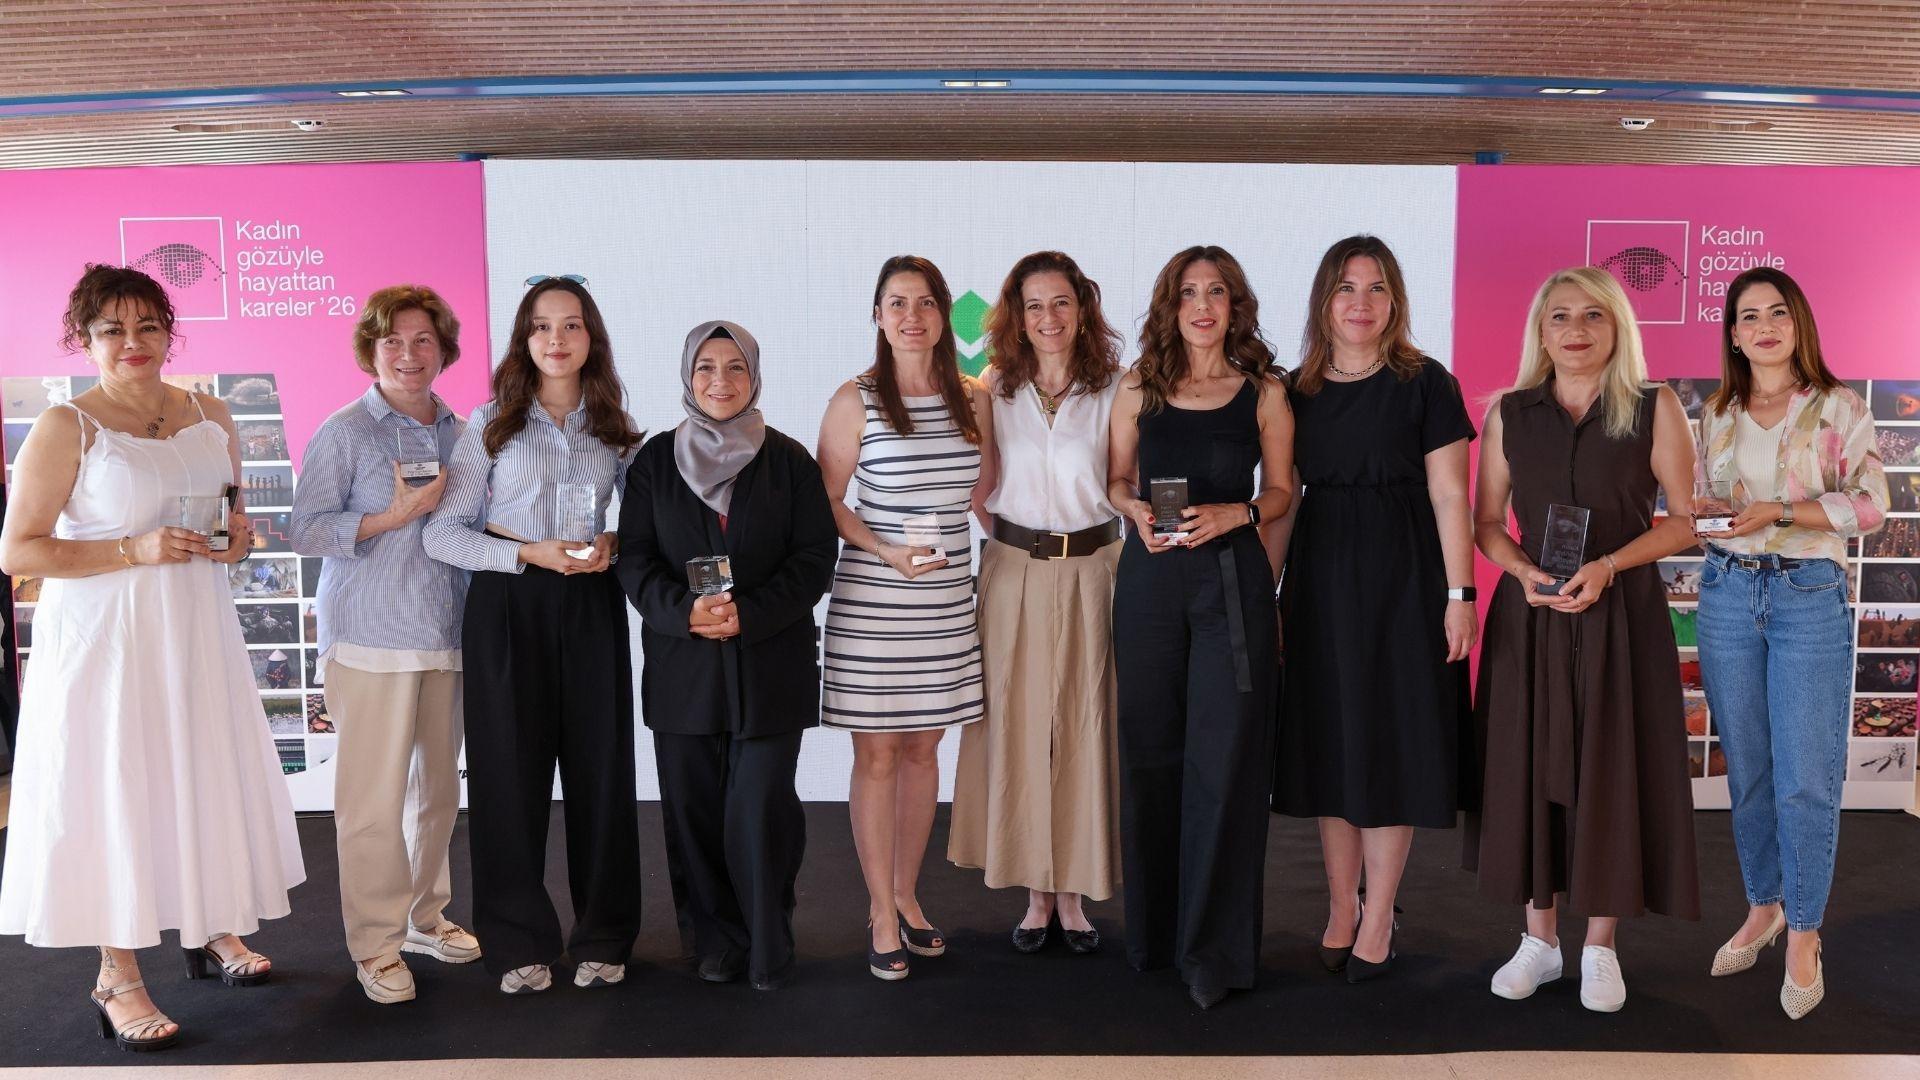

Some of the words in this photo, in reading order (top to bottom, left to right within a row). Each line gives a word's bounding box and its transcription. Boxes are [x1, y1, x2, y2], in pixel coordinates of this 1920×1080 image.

[236, 220, 300, 240] Kadın
[1701, 225, 1764, 246] Kadın
[237, 246, 324, 271] gözüyle
[238, 272, 335, 296] hayattan
[240, 298, 316, 317] kareler
